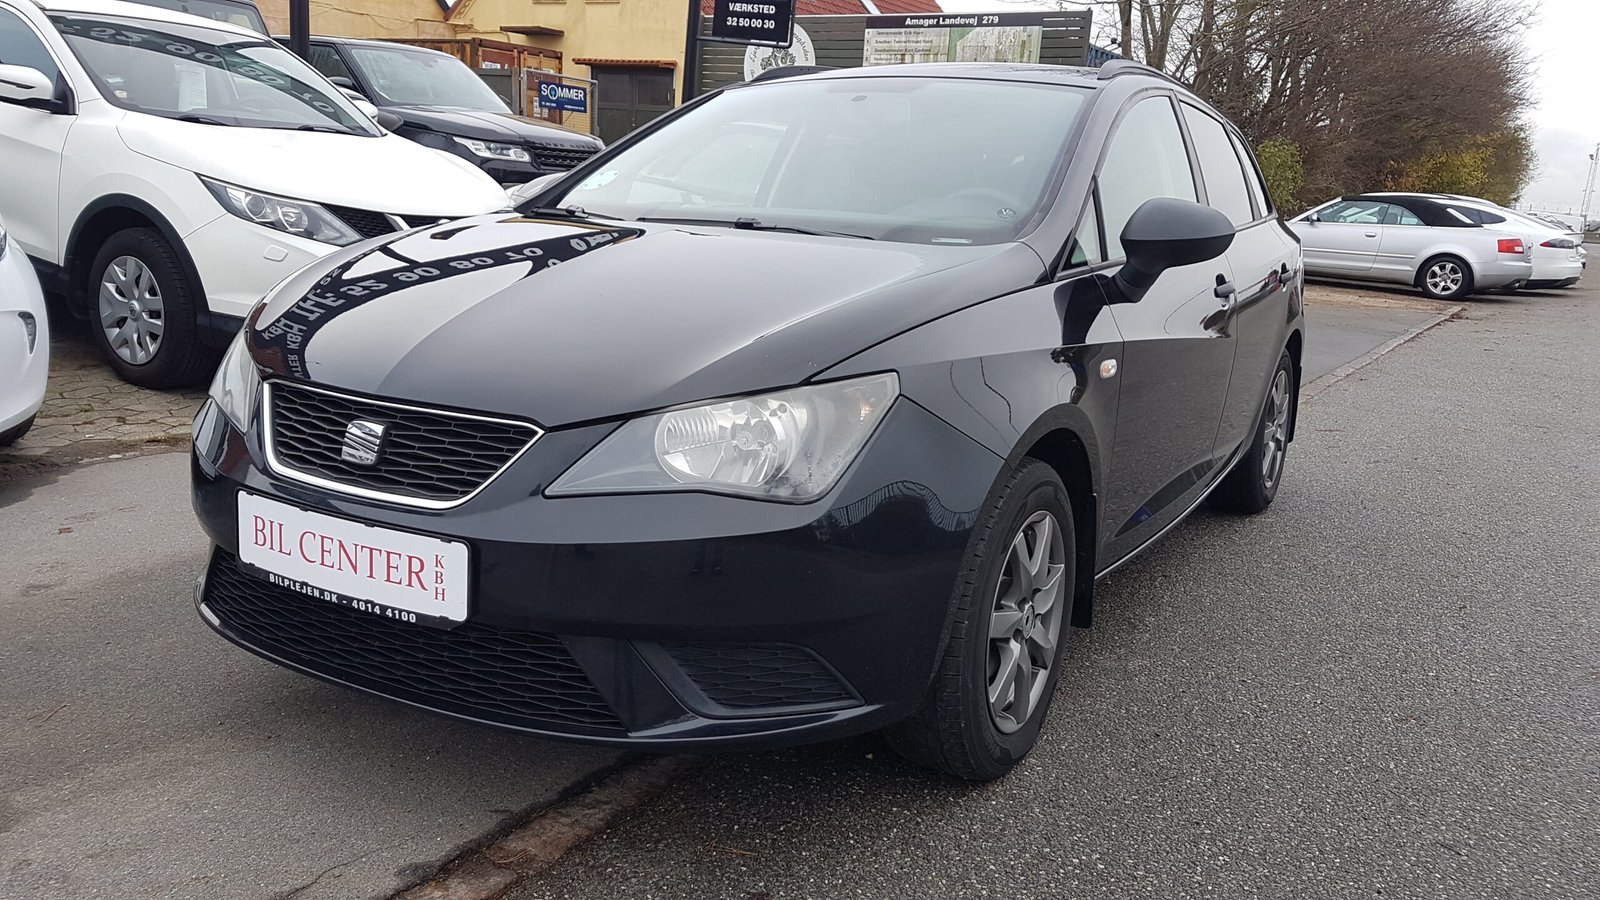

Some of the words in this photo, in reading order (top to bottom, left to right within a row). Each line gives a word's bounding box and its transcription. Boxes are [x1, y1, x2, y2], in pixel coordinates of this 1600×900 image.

[729, 2, 776, 14] VÆRKSTED
[726, 17, 738, 26] 32
[738, 18, 750, 27] 50
[750, 19, 762, 28] 00
[763, 20, 775, 29] 30
[905, 17, 937, 27] Amager
[939, 15, 978, 26] Landevej
[982, 16, 999, 24] 279
[541, 84, 585, 101] SOMMER
[252, 514, 292, 557] BIL
[298, 530, 429, 592] CENTER
[269, 573, 339, 603] BILPLEJEN.DK
[351, 600, 381, 615] 4014
[385, 608, 417, 623] 4100
